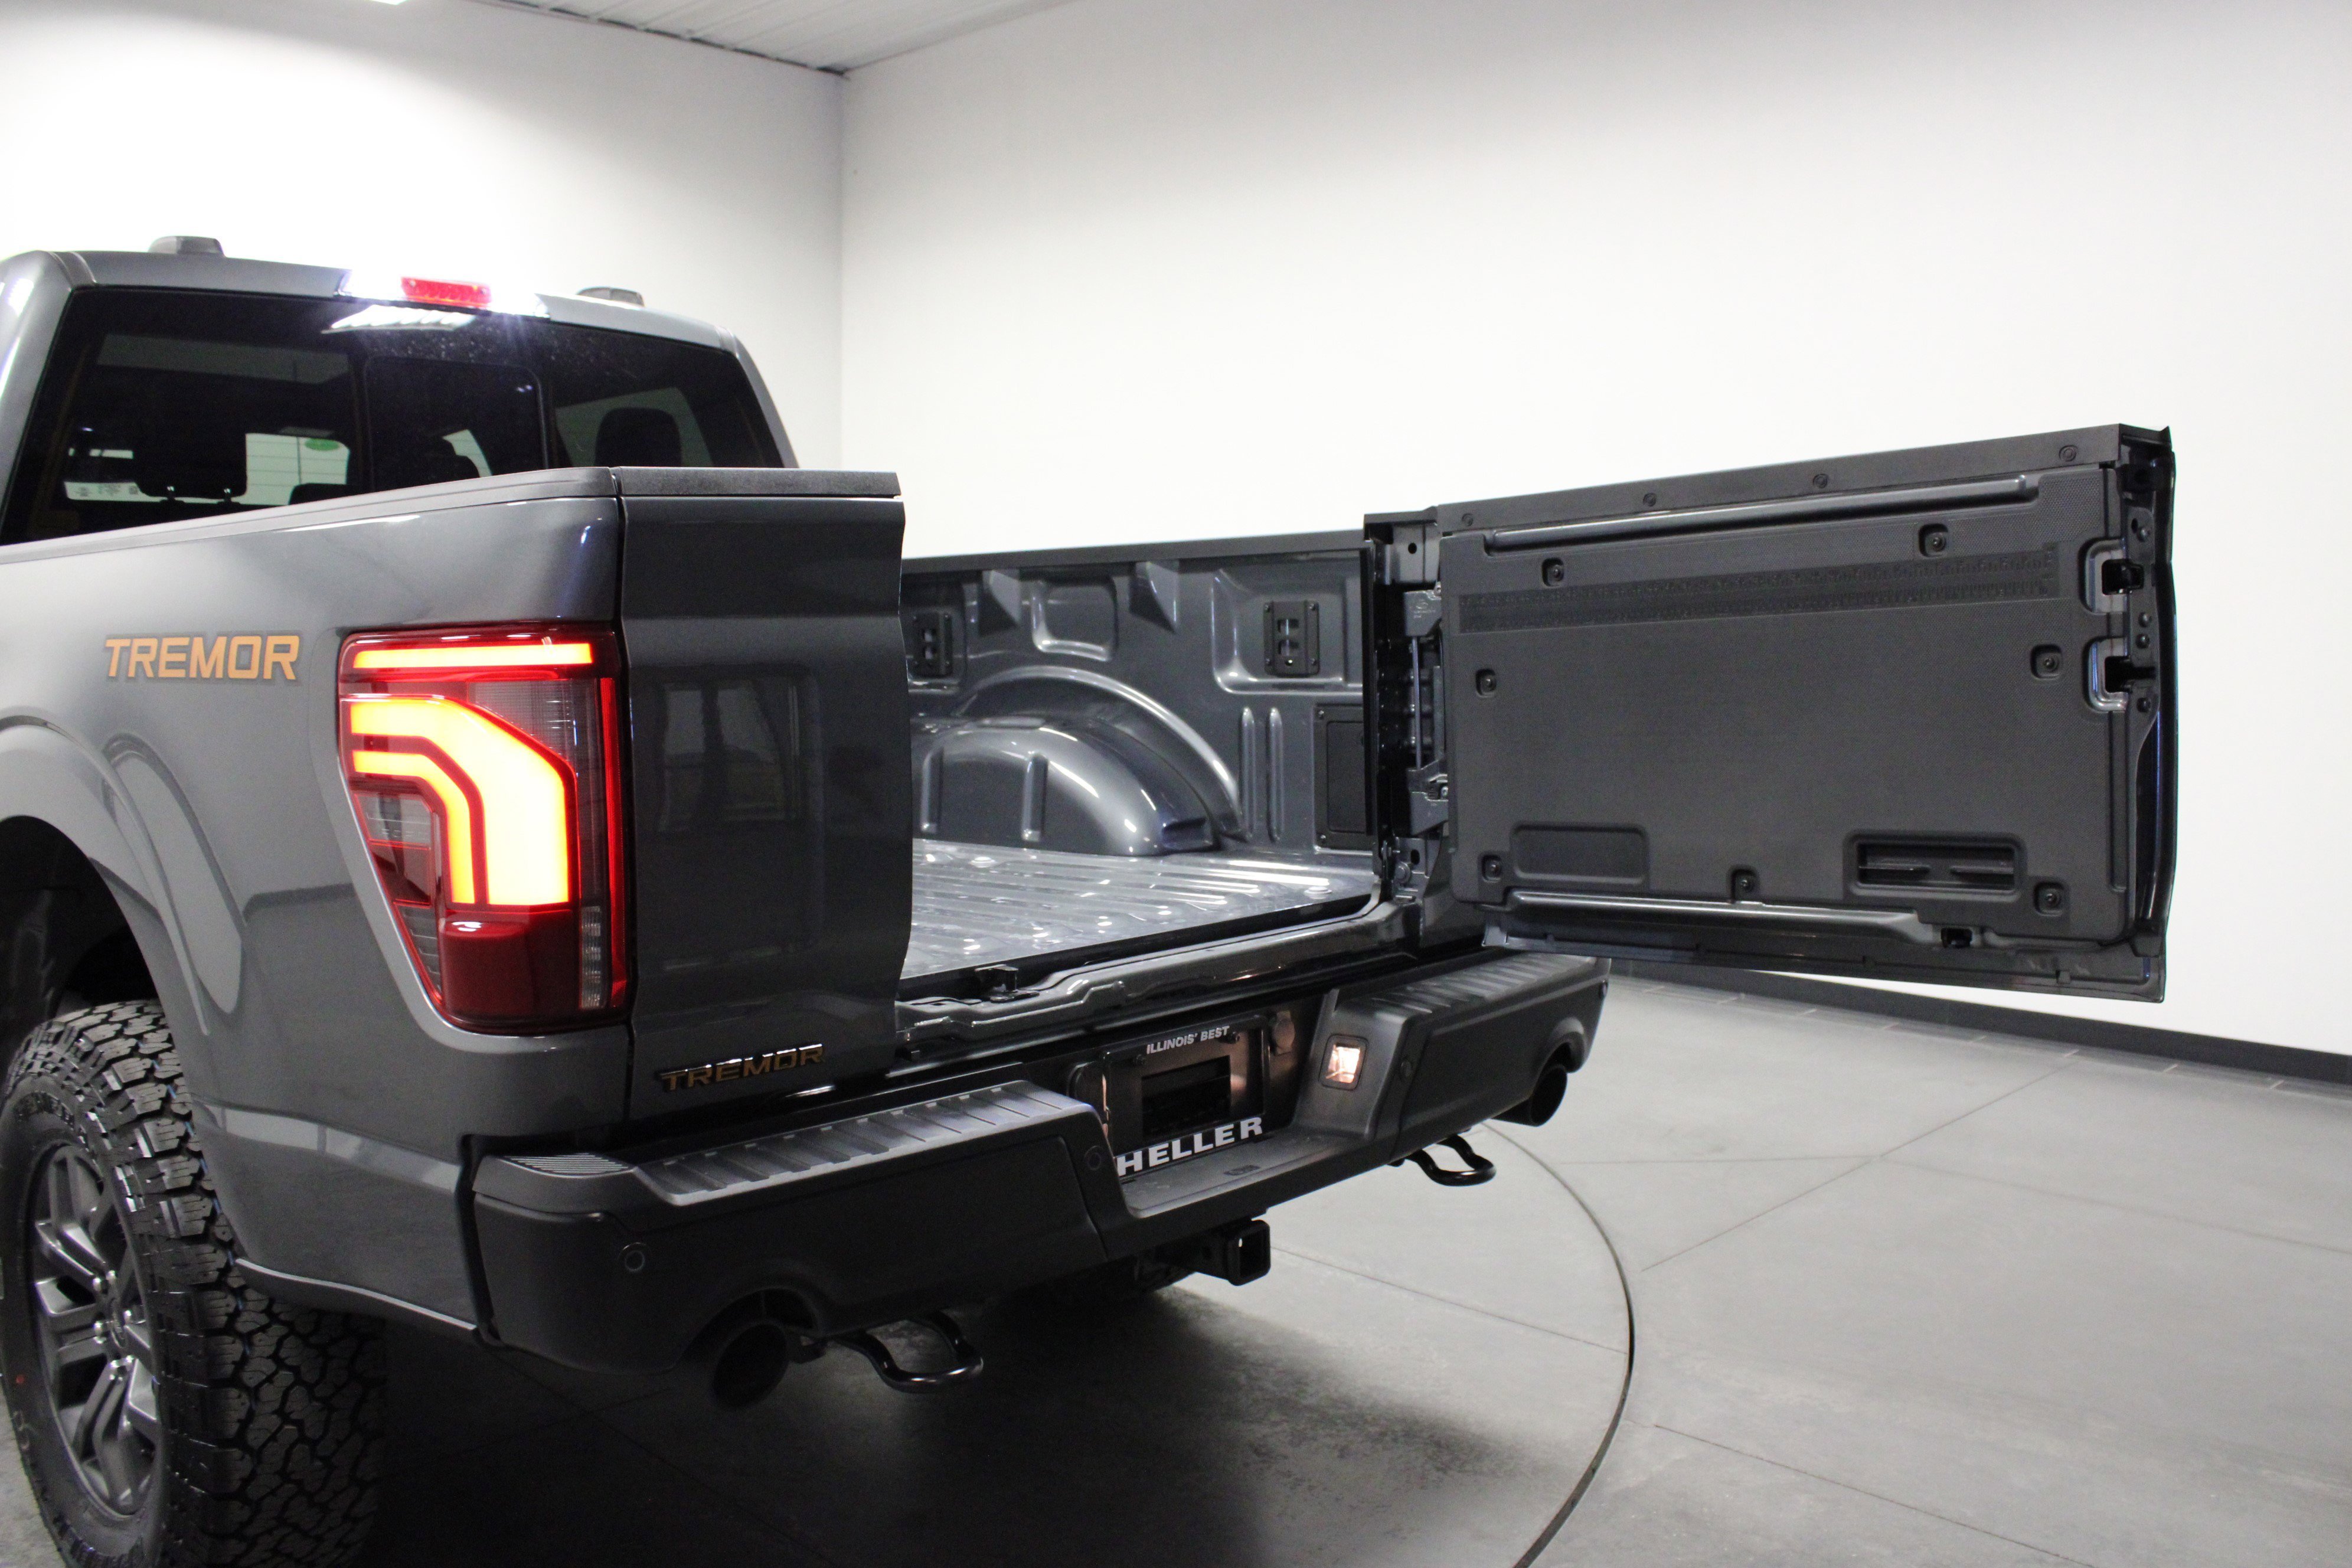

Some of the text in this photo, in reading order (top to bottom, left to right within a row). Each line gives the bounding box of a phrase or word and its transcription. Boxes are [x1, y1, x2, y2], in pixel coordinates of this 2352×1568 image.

[105, 635, 300, 680] TREMOR
[1146, 1025, 1230, 1054] ILLINOIS' BEST
[659, 1043, 824, 1091] TREMOR
[1116, 1116, 1263, 1177] HELLER
